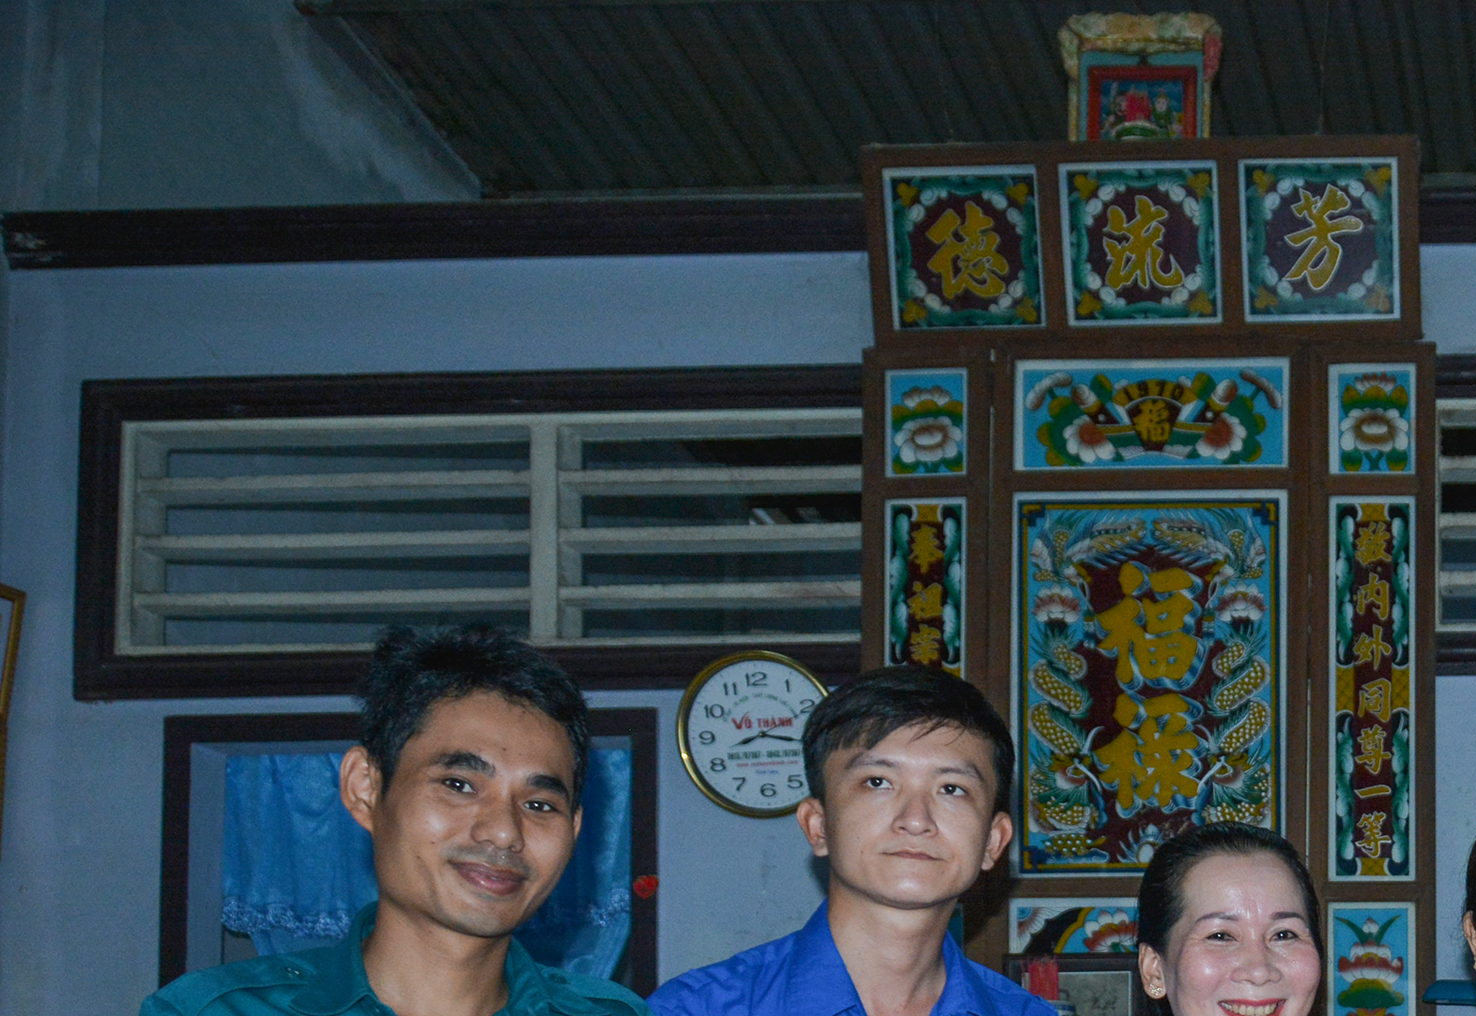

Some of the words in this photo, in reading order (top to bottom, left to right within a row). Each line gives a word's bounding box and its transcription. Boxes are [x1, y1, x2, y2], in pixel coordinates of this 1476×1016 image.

[745, 671, 768, 687] 12
[723, 682, 738, 696] 11
[703, 703, 725, 718] 10
[799, 698, 816, 714] 2
[698, 730, 716, 745] 9
[710, 757, 727, 772] 8
[732, 776, 747, 791] 7
[787, 774, 804, 789] 5
[760, 783, 777, 798] 6
